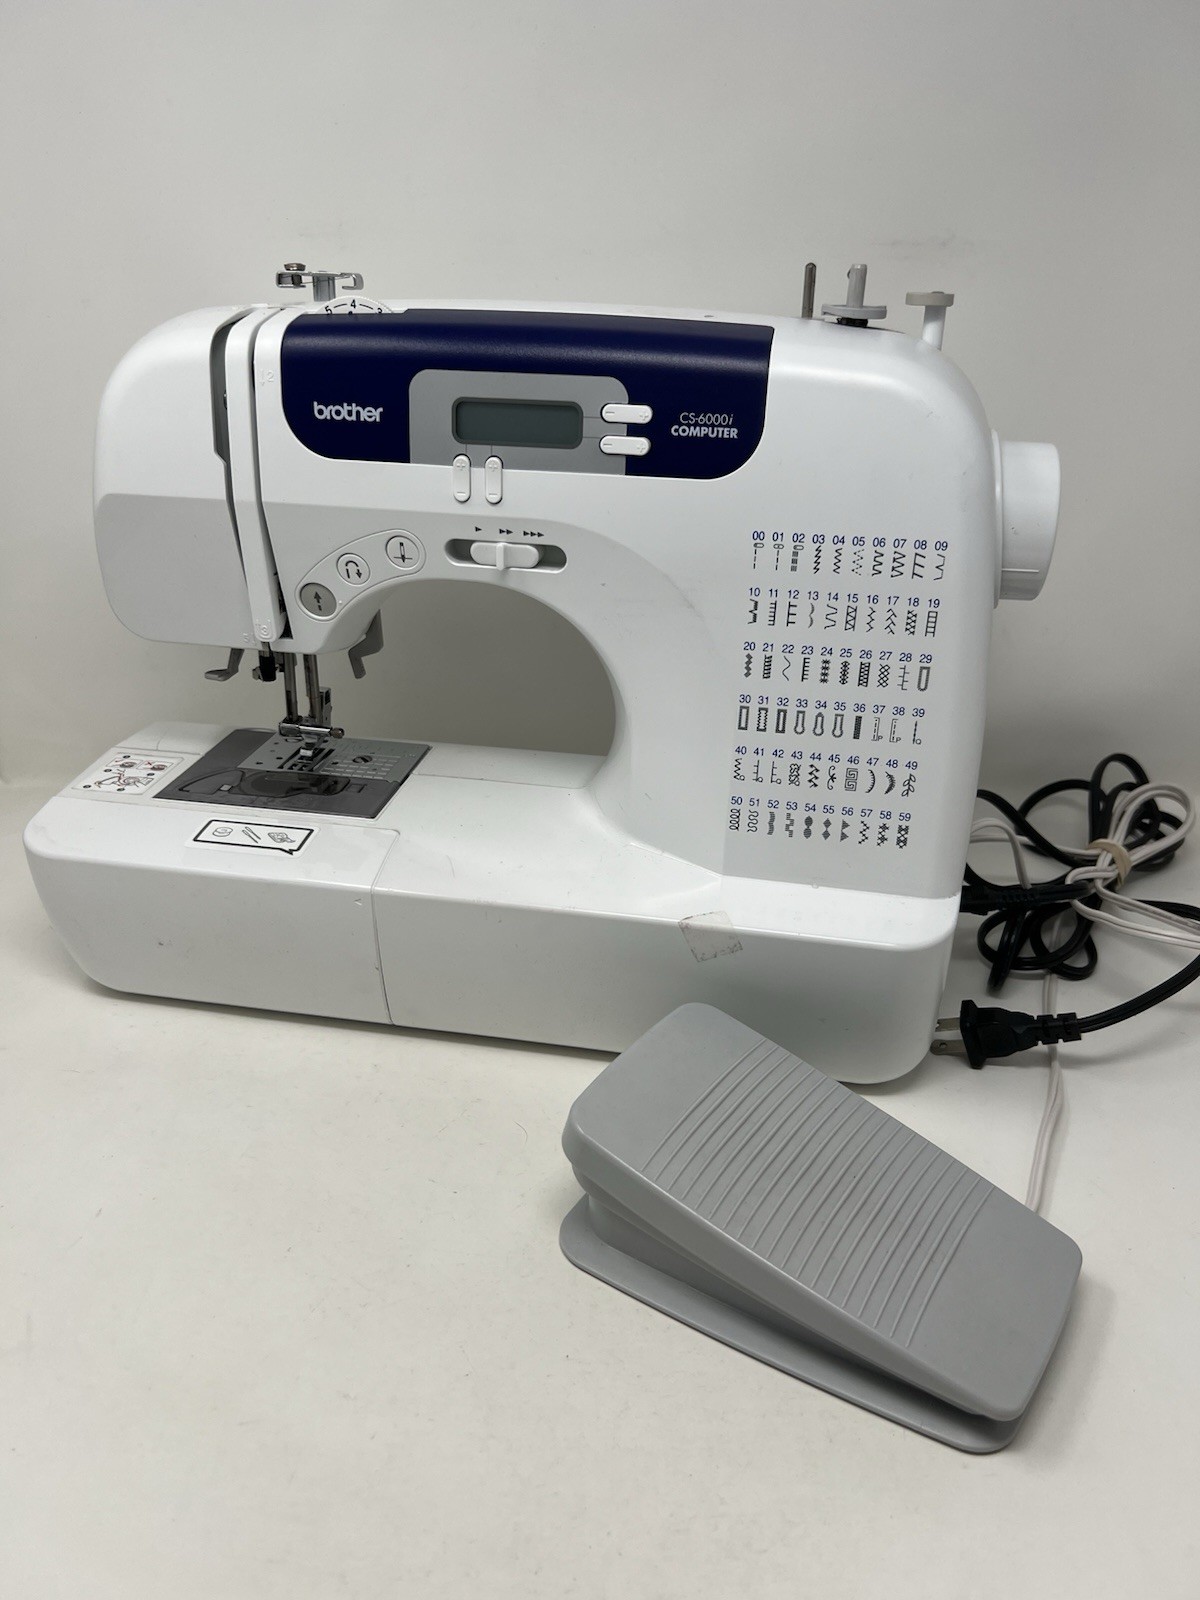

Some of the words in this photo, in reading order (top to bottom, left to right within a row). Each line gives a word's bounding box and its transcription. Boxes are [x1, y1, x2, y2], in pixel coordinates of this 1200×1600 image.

[350, 299, 357, 309] 4
[313, 401, 383, 422] brother
[679, 412, 734, 425] CS-6000i
[671, 425, 739, 439] COMPUTER
[753, 531, 765, 541] 00
[772, 532, 783, 541] 01
[792, 533, 805, 543] 02
[812, 534, 825, 544] 03
[833, 535, 845, 545] 04
[852, 536, 865, 546] 05
[873, 537, 886, 547] 06
[893, 539, 907, 548] 07
[914, 540, 927, 550] 08
[935, 541, 948, 551] 09
[749, 588, 760, 597] 10
[769, 589, 778, 597] 11
[788, 590, 799, 599] 12
[808, 591, 818, 600] 13
[828, 592, 838, 601] 14
[847, 594, 858, 603] 15
[867, 595, 878, 604] 16
[888, 596, 899, 605] 17
[908, 598, 919, 607] 18
[929, 599, 940, 608] 19
[744, 642, 755, 651] 20
[763, 643, 773, 652] 21
[782, 644, 794, 653] 22
[801, 646, 813, 655] 23
[821, 647, 832, 656] 24
[840, 648, 852, 658] 25
[859, 650, 872, 659] 26
[879, 651, 892, 660] 27
[899, 653, 912, 662] 28
[919, 654, 932, 663] 29
[739, 694, 751, 703] 30
[758, 696, 768, 704] 31
[777, 697, 789, 706] 32
[796, 699, 808, 708] 33
[815, 700, 827, 709] 34
[834, 702, 846, 711] 35
[853, 703, 865, 712] 36
[873, 705, 885, 713] 37
[892, 706, 905, 716] 38
[912, 708, 925, 717] 39
[735, 746, 746, 755] 40
[754, 748, 764, 756] 41
[772, 749, 784, 758] 42
[791, 751, 802, 759] 43
[810, 753, 821, 761] 44
[828, 754, 840, 763] 45
[847, 756, 859, 764] 46
[867, 758, 879, 766] 47
[886, 759, 898, 768] 48
[905, 761, 918, 770] 49
[731, 796, 742, 805] 50
[749, 798, 759, 806] 51
[768, 800, 779, 809] 52
[786, 801, 797, 810] 53
[805, 803, 816, 812] 54
[823, 805, 834, 814] 55
[842, 807, 853, 816] 56
[861, 809, 873, 817] 57
[880, 811, 891, 820] 58
[899, 813, 911, 821] 59
